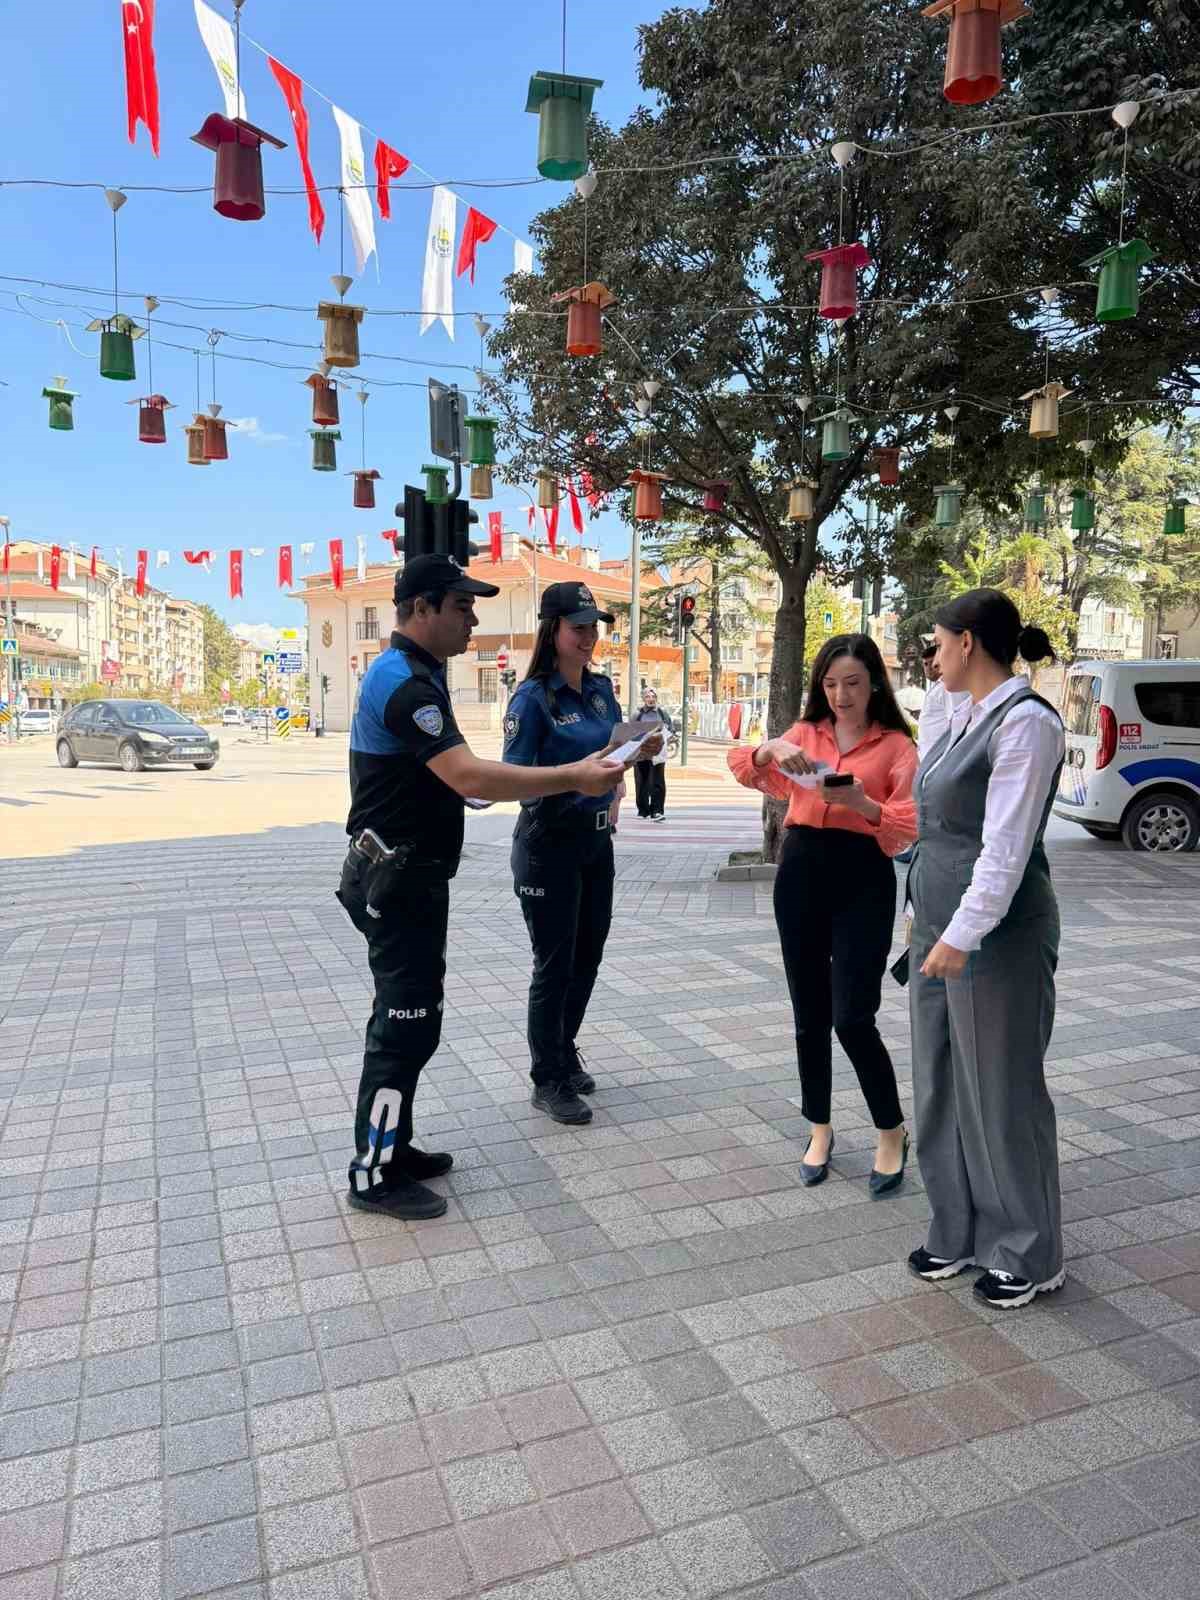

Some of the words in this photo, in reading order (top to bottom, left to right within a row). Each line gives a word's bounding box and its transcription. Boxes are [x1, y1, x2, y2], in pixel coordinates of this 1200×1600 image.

[1122, 725, 1138, 736] 112
[519, 886, 545, 897] POLIS
[388, 1008, 427, 1019] POLIS
